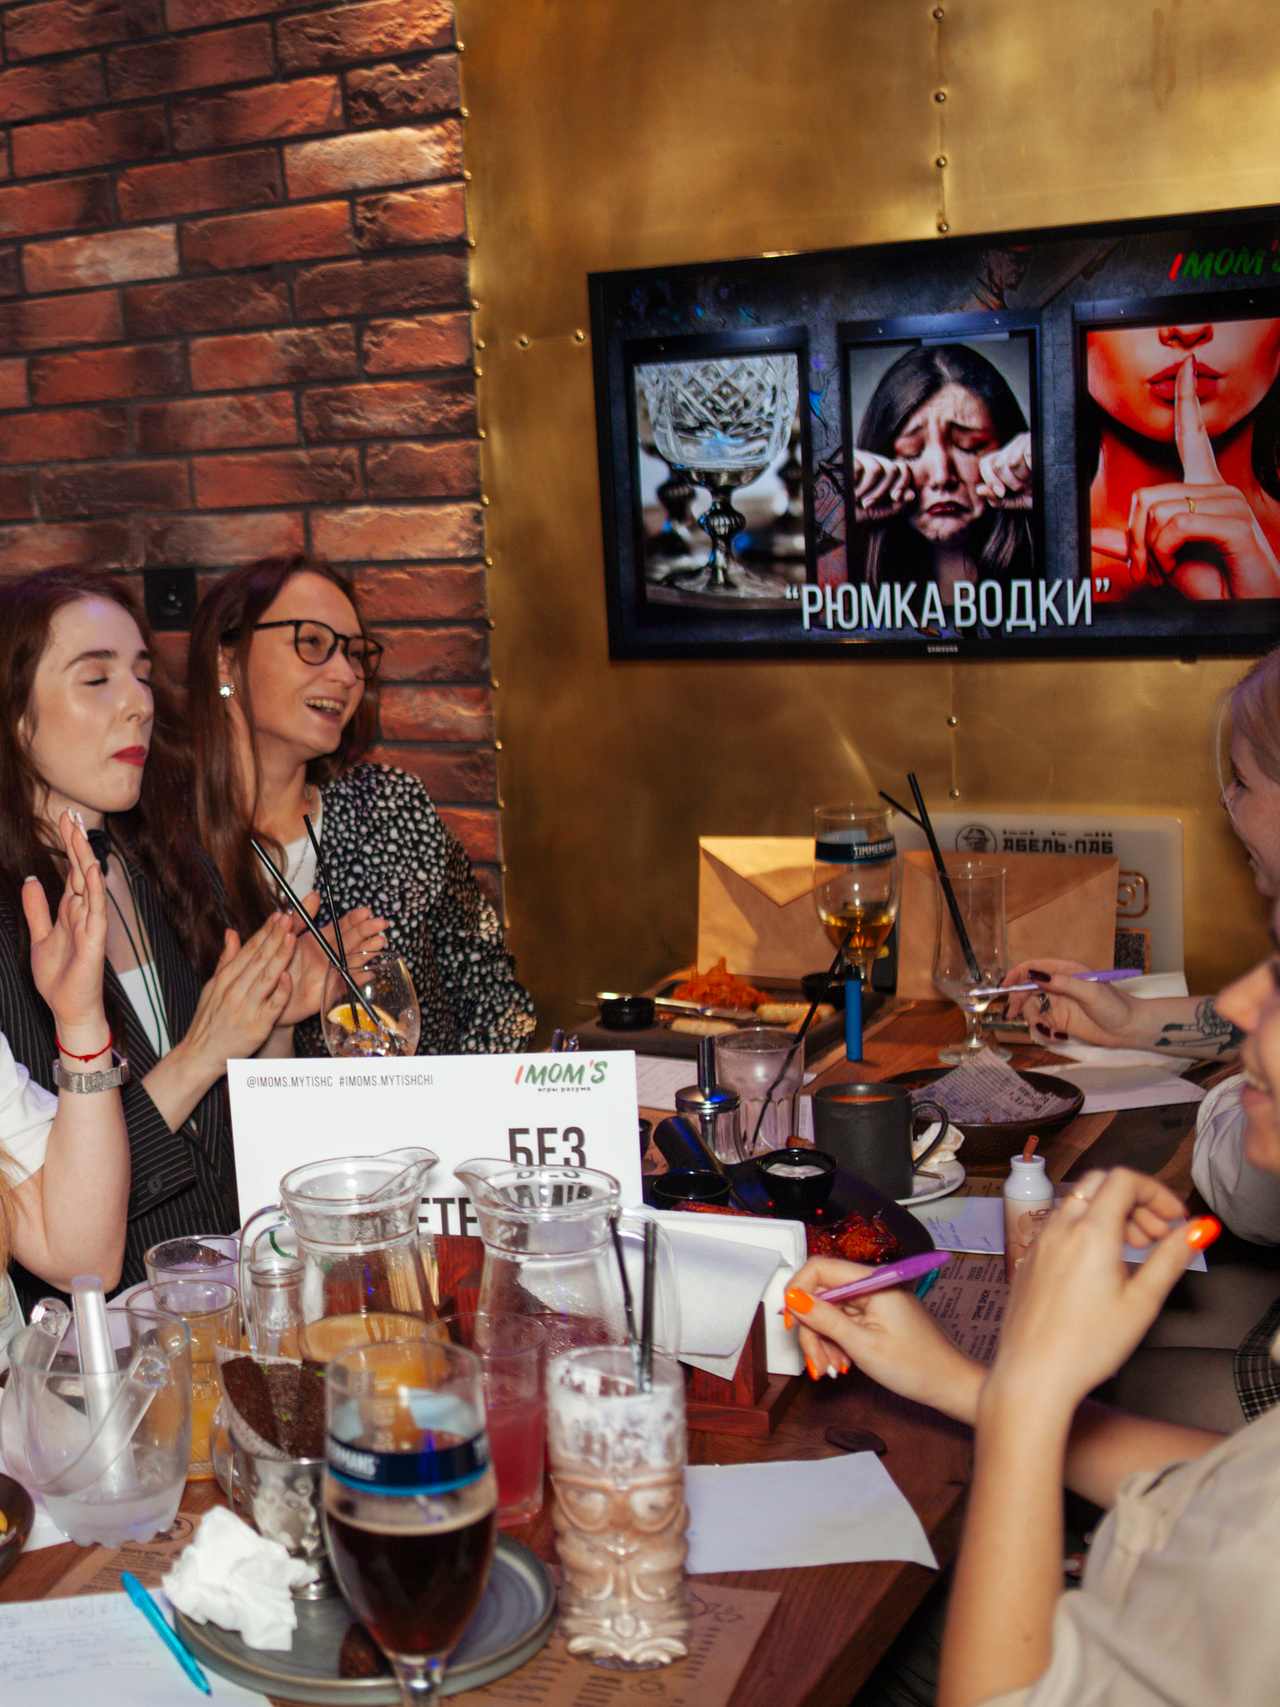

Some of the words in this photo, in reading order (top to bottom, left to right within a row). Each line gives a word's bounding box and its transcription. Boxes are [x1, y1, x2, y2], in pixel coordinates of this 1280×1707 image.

[246, 1075, 333, 1088] @IMOMS.MYTISHC
[339, 1074, 434, 1087] #IMOMS.MYTISHCHI
[515, 1059, 608, 1086] IMOM'S
[508, 1126, 587, 1178] БЕЗ
